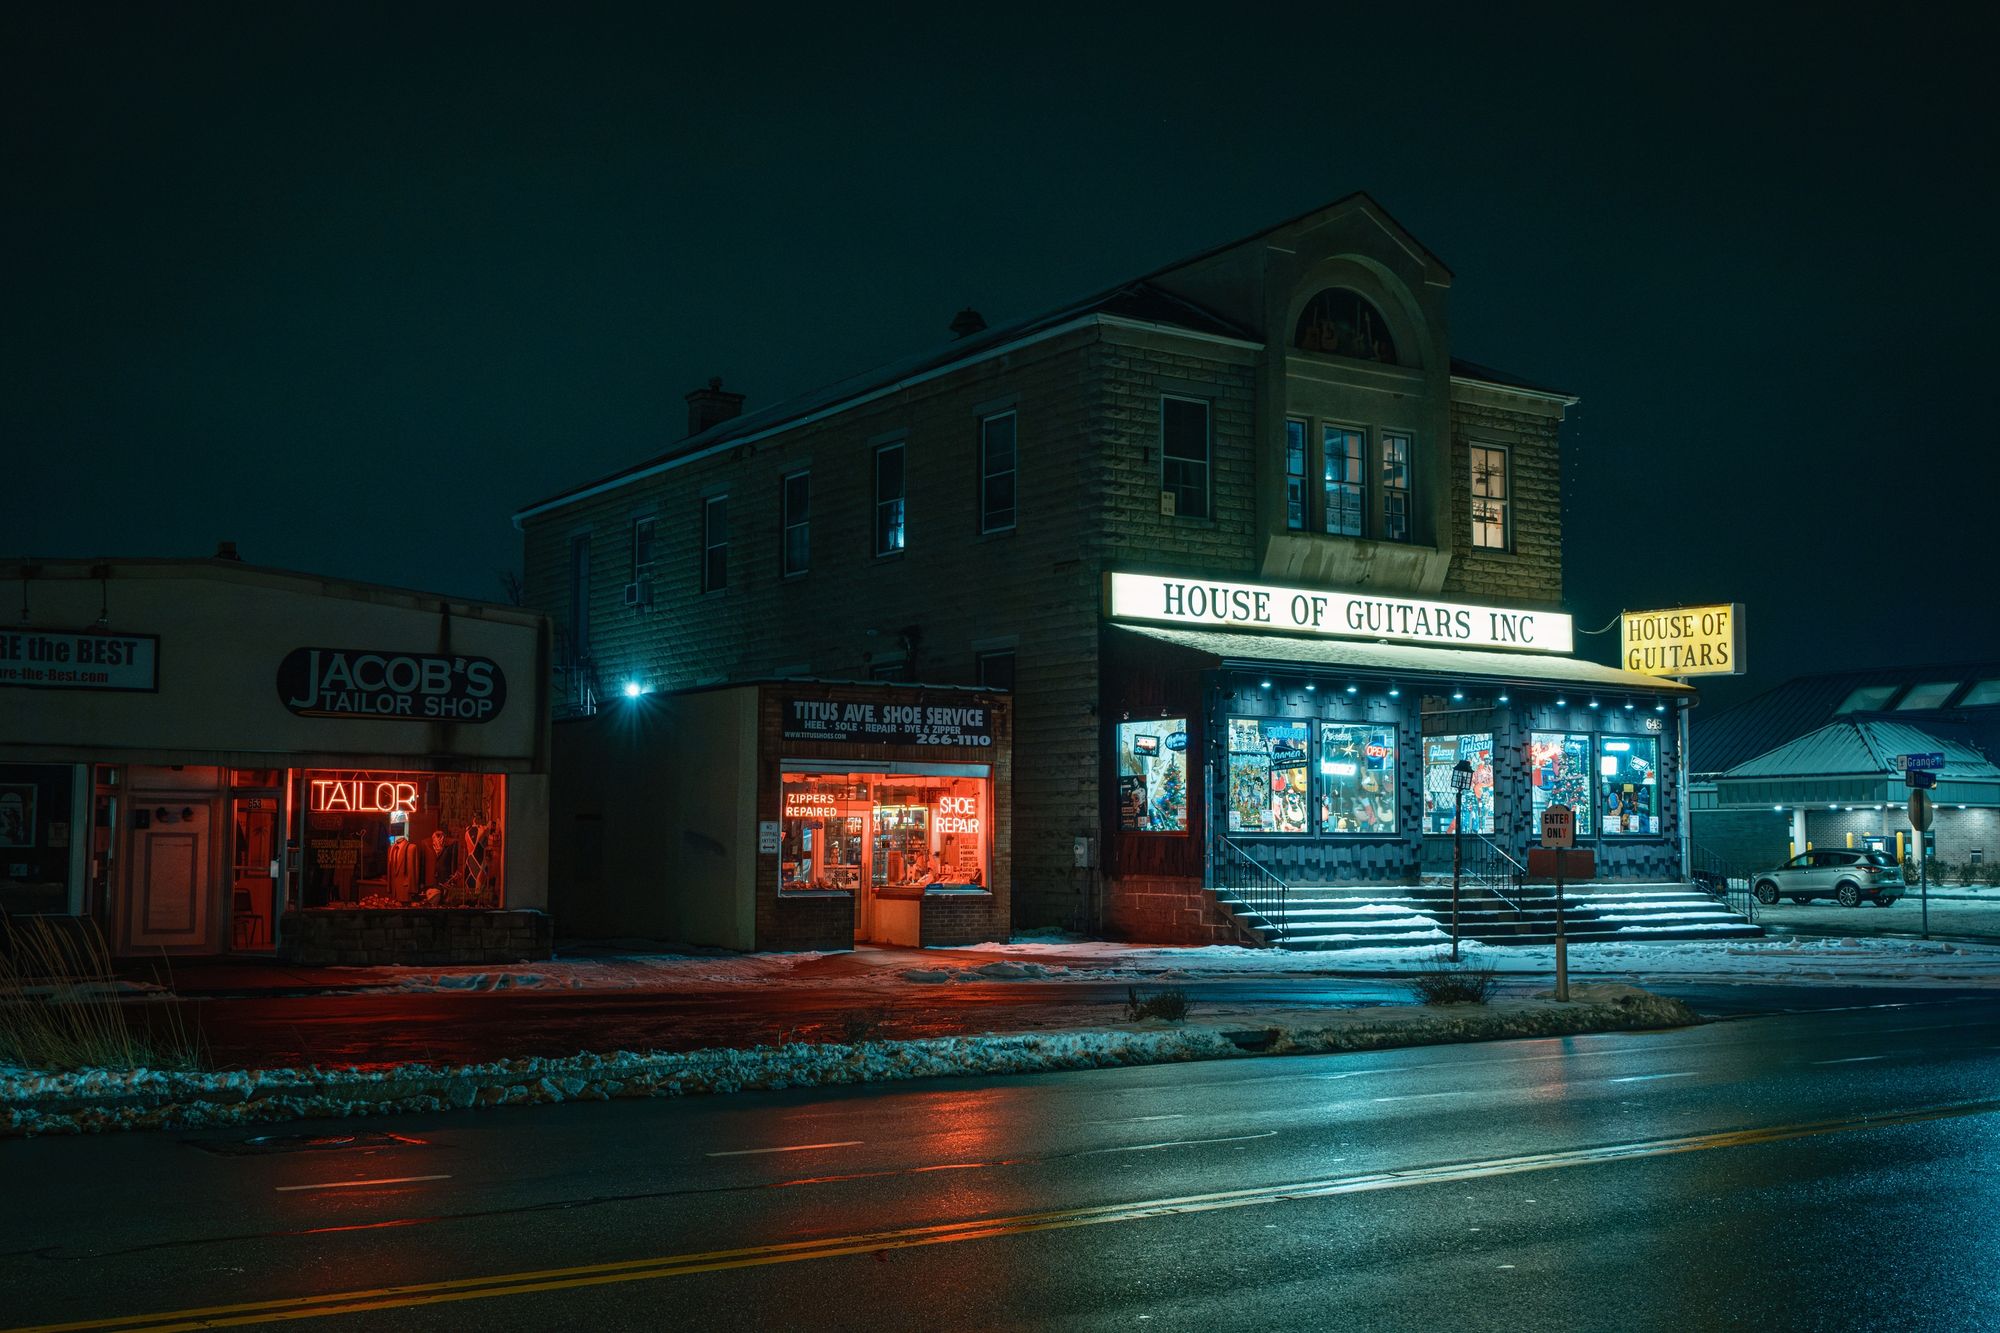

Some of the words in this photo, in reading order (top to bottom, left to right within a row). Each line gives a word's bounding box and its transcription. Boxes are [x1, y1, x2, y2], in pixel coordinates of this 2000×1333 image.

[1163, 583, 1270, 622] HOUSE
[1291, 595, 1328, 626] OF
[1346, 600, 1471, 639] GUITARS
[1489, 612, 1534, 643] INC
[1629, 615, 1694, 641] HOUSE
[1702, 612, 1727, 636] OF
[28, 637, 70, 662] the
[77, 639, 138, 665] BEST
[1629, 643, 1728, 670] GUITARS
[288, 650, 494, 709] JACOB'S
[320, 691, 413, 714] TAILOR
[424, 697, 492, 718] SHOP
[793, 701, 838, 720] TITUS
[843, 703, 878, 724] AVE.
[882, 706, 923, 725] SHOE
[926, 707, 984, 728] SERVICE
[804, 721, 828, 730] HEEL
[835, 722, 858, 732] SOLE
[865, 723, 897, 733] REPAIR
[904, 724, 922, 734] DYE
[932, 726, 961, 735] ZIPPER
[1646, 718, 1663, 730] 645
[916, 734, 992, 747] 266-1110
[1460, 736, 1491, 760] Gibson
[1366, 746, 1387, 758] OPEN
[1907, 757, 1936, 769] Grange
[313, 781, 417, 811] TAILOR
[789, 794, 836, 804] ZIPPERS
[786, 807, 838, 817] REPAIRED
[940, 797, 976, 815] SHOE
[935, 817, 980, 834] REPAIR
[1545, 814, 1569, 824] ENTER
[1547, 828, 1567, 839] ONLY
